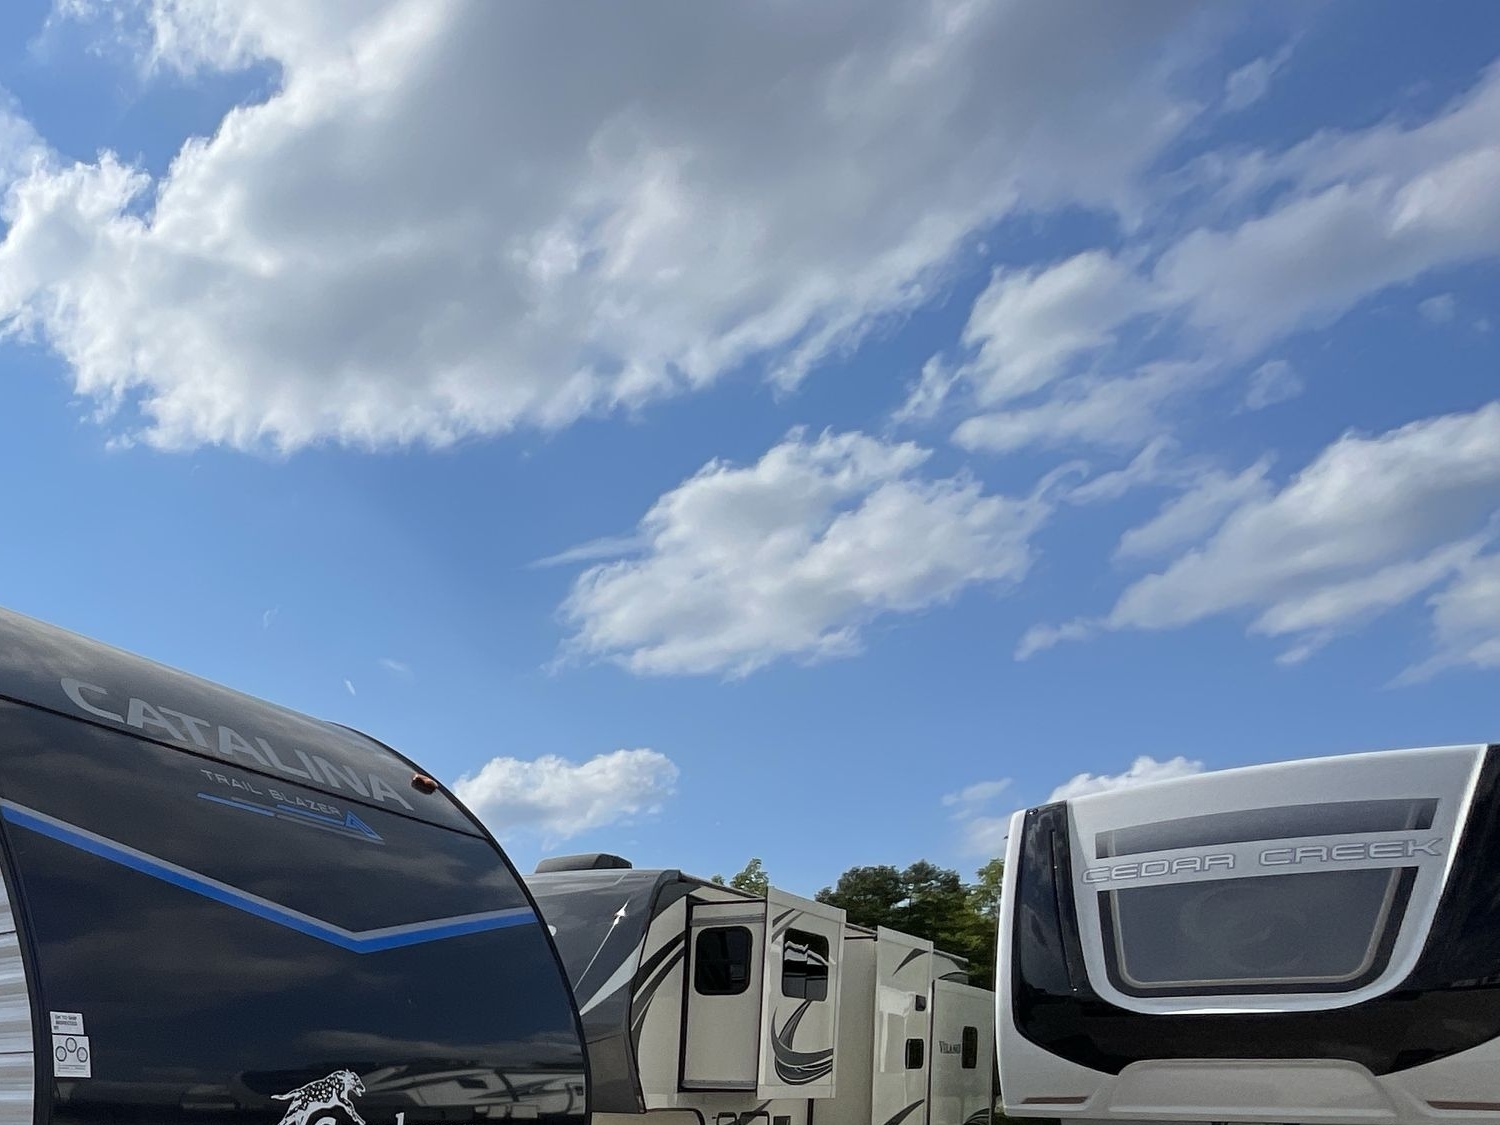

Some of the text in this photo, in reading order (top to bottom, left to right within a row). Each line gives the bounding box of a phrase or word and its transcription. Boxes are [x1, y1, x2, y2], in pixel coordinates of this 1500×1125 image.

[60, 677, 414, 812] CATALINA
[201, 768, 343, 817] TRAIL BLAZER
[1081, 837, 1444, 884] CEDAR CREEK
